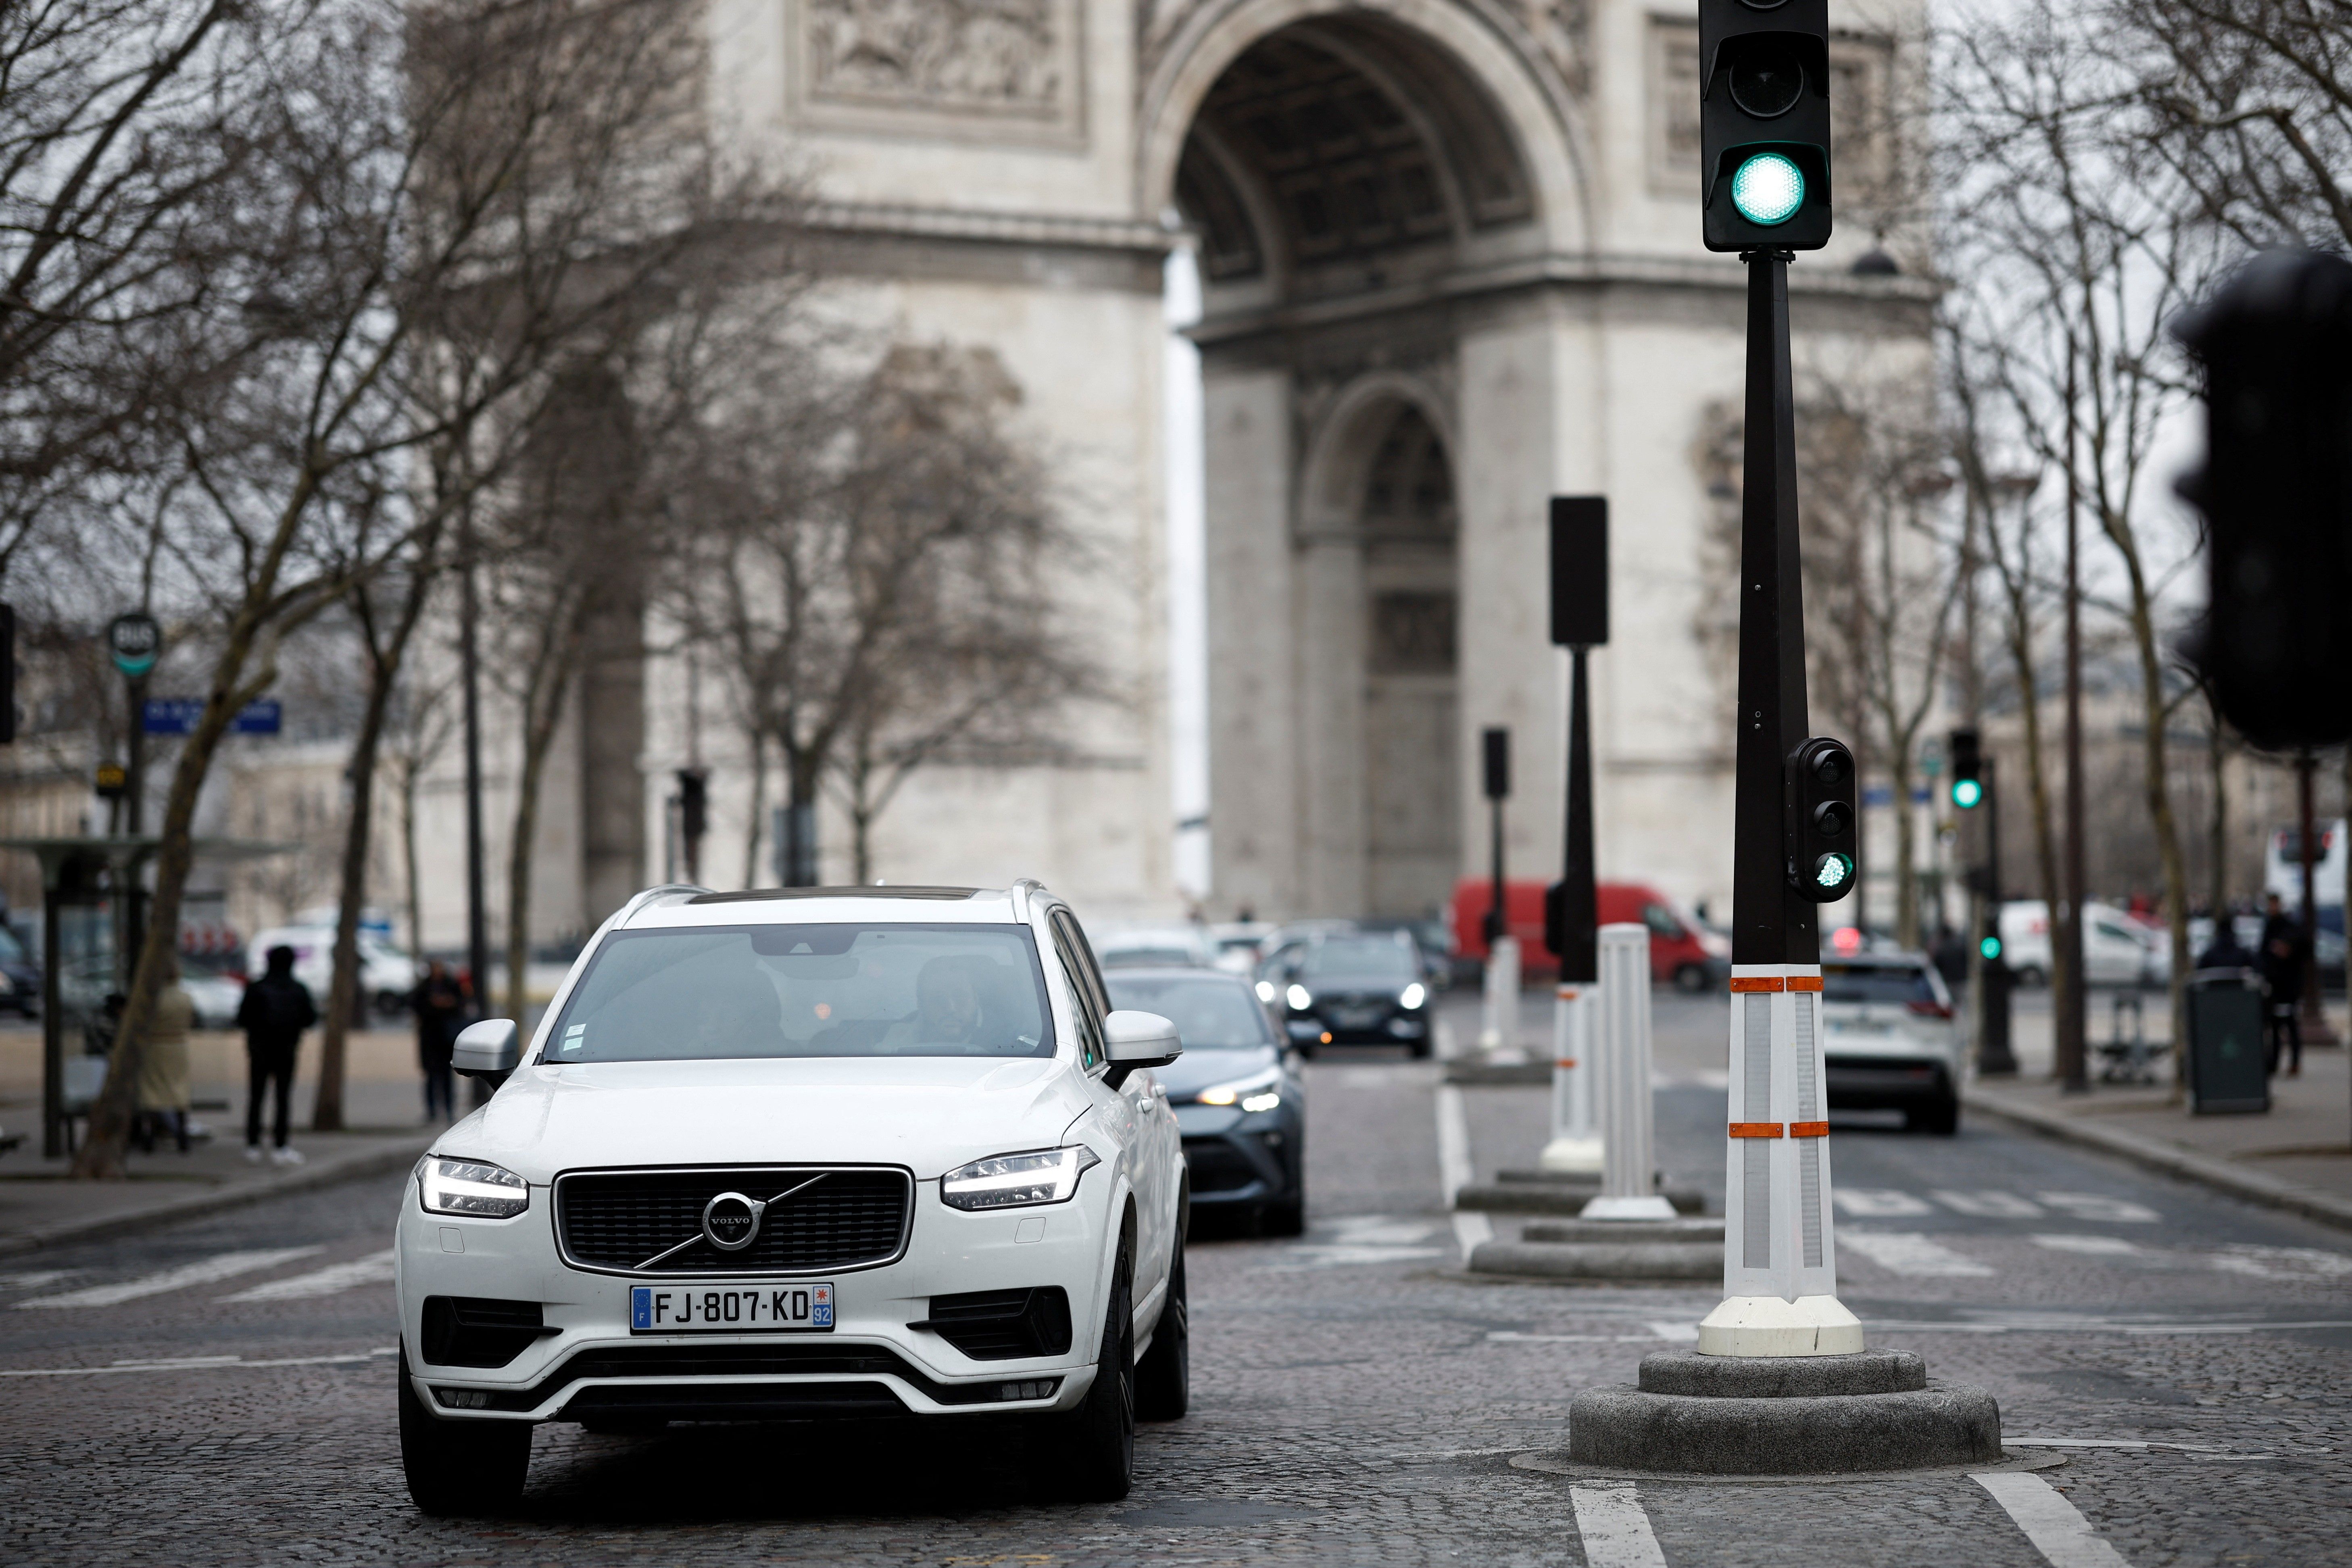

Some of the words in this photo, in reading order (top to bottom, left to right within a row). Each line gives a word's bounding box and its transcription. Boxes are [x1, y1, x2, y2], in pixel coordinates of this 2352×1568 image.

[655, 1291, 809, 1323] FJ-807-KD
[814, 1307, 830, 1322] 92
[639, 1313, 644, 1322] F
